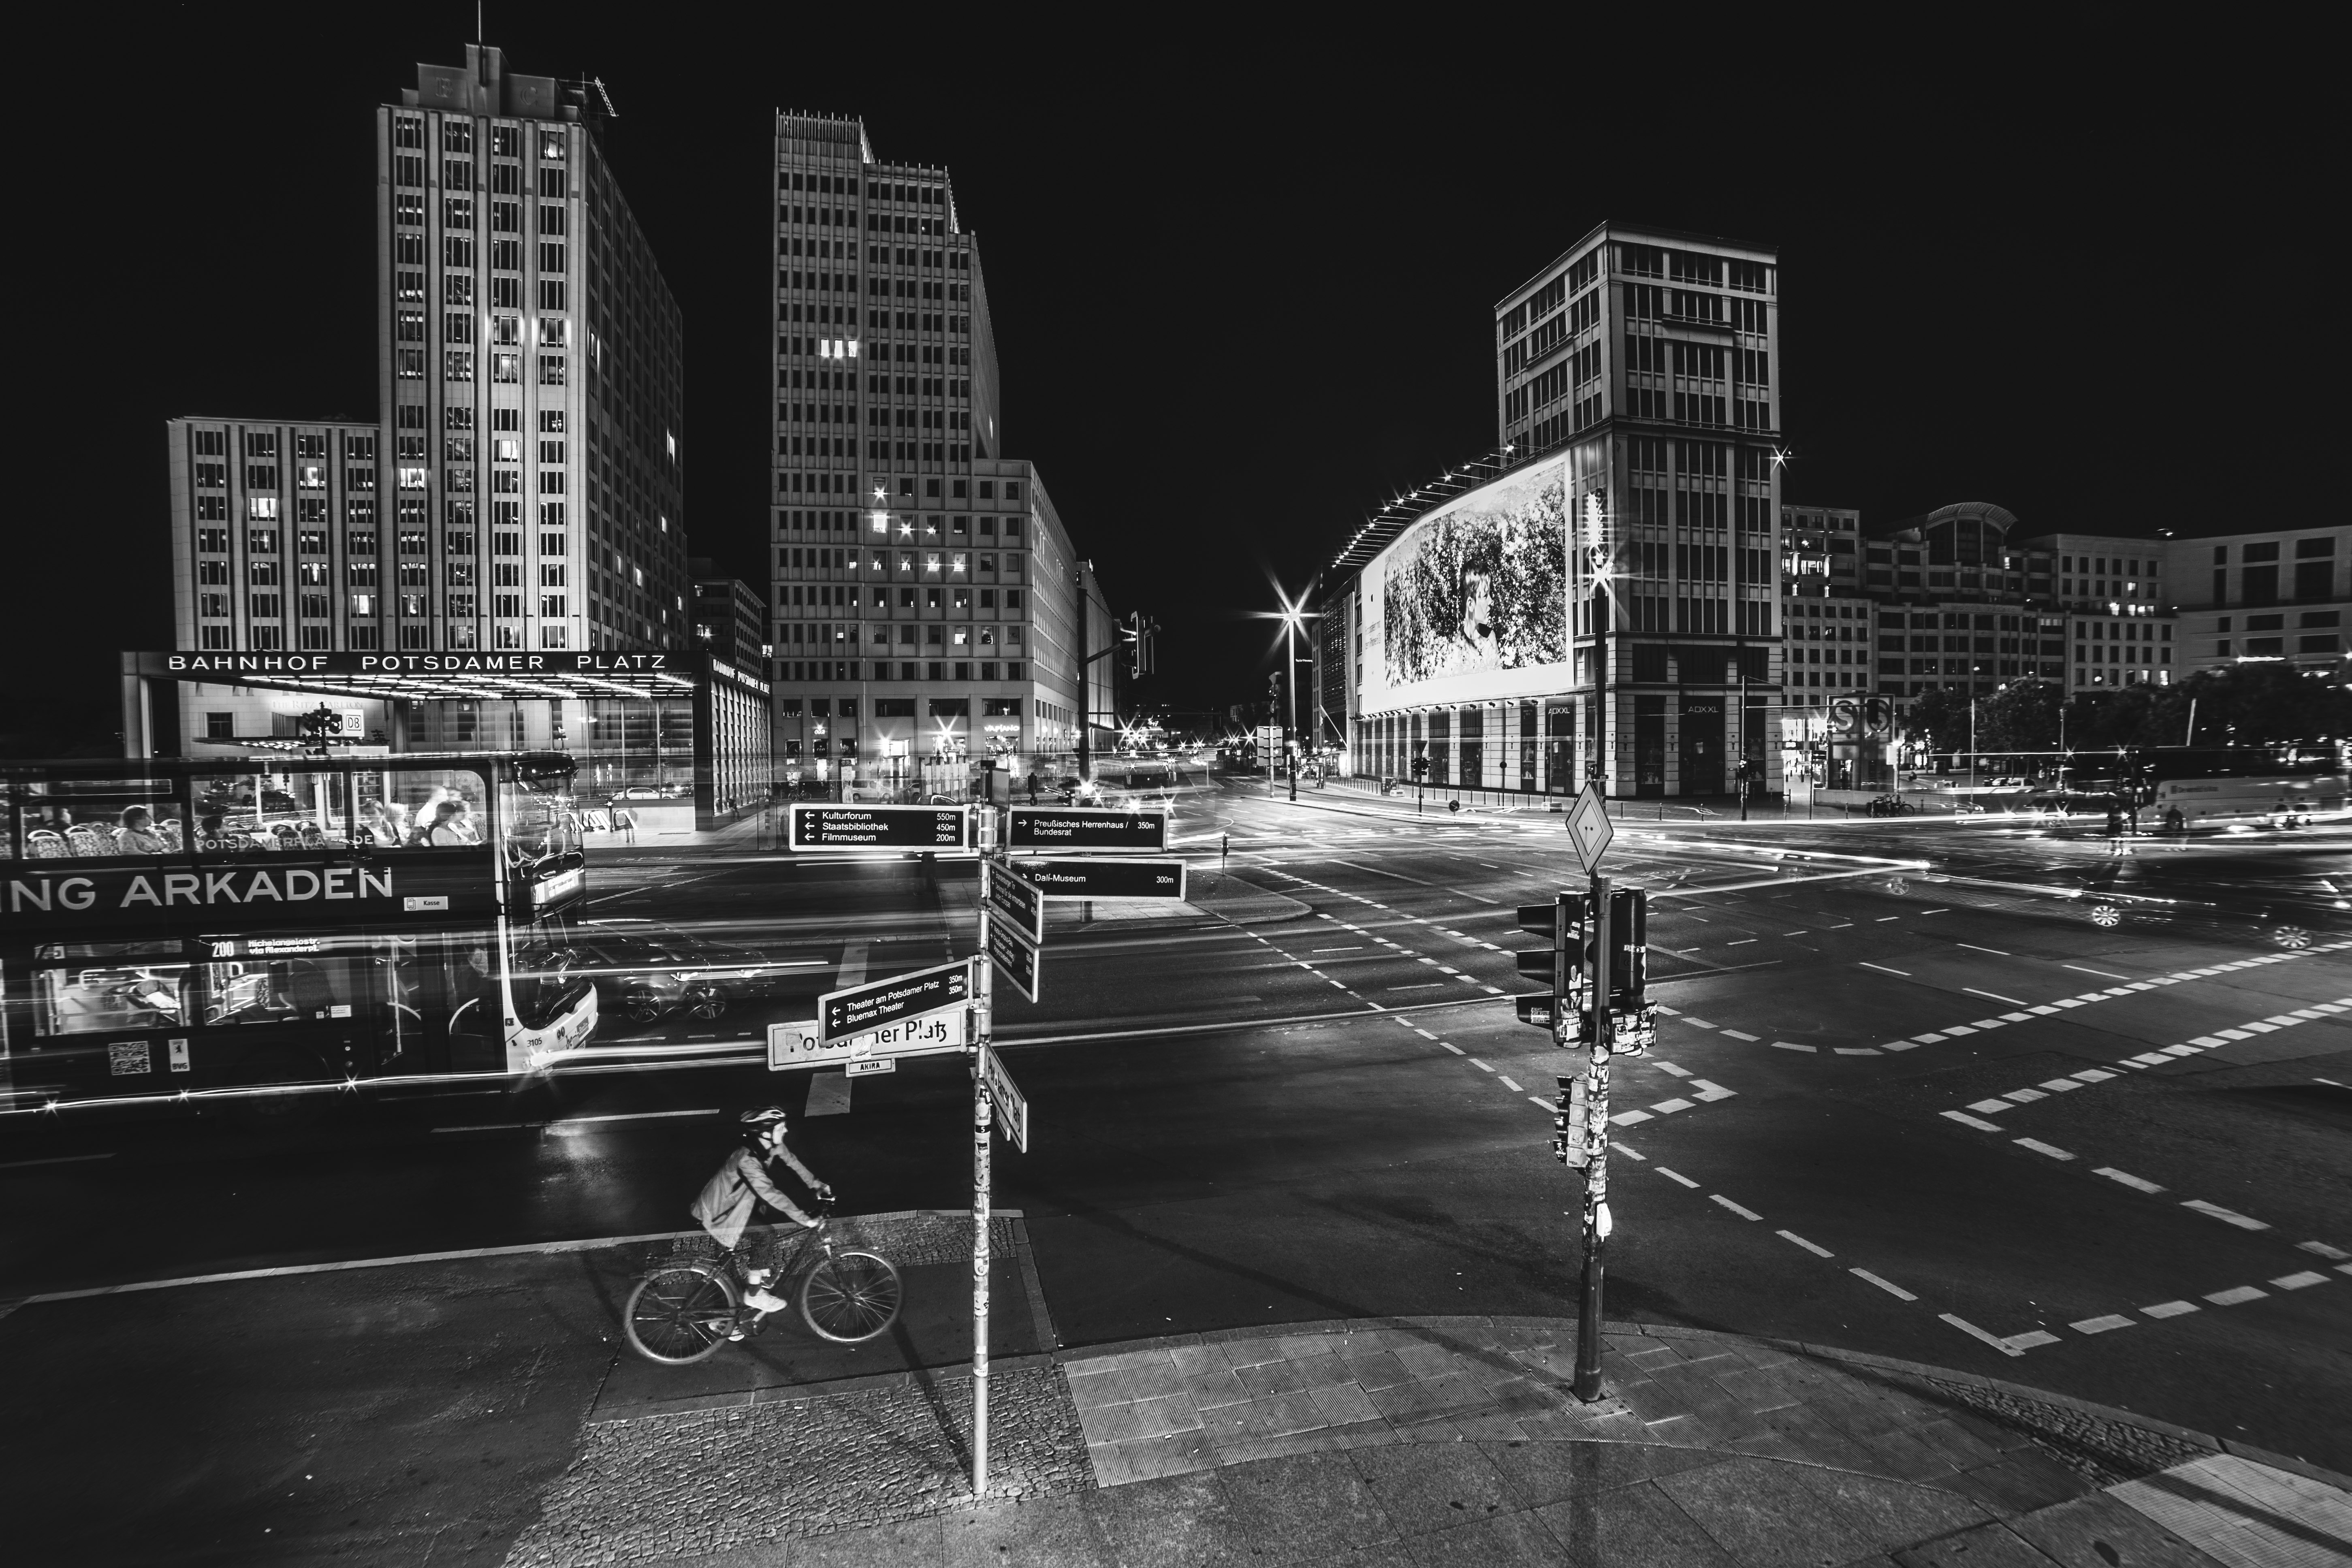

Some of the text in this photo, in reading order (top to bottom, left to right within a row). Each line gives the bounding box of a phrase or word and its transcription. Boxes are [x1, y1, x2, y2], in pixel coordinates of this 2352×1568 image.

[169, 655, 665, 670] BAHNHOF POTSDAMER PLATZ
[348, 717, 360, 728] DB
[822, 811, 871, 820] Kulturforum
[822, 822, 956, 831] Staatsbibliothek 450m
[1034, 819, 1080, 828] Preußisches
[1082, 821, 1124, 829] Herrenhaus
[822, 832, 876, 841] Filmmuseum
[1034, 828, 1071, 836] Bundesrat
[1035, 873, 1174, 884] Dalí-Museum 300m
[120, 867, 392, 907] ARKADEN
[211, 938, 320, 957] 200 Michelangelostr.
[265, 944, 319, 954] Alexanderpl.
[847, 975, 963, 1012] Theater am Potsdamer Platz 350m
[847, 986, 963, 1024] Bluemax Theater 350m
[527, 1037, 542, 1047] 3105
[860, 1062, 880, 1071] AKIRA
